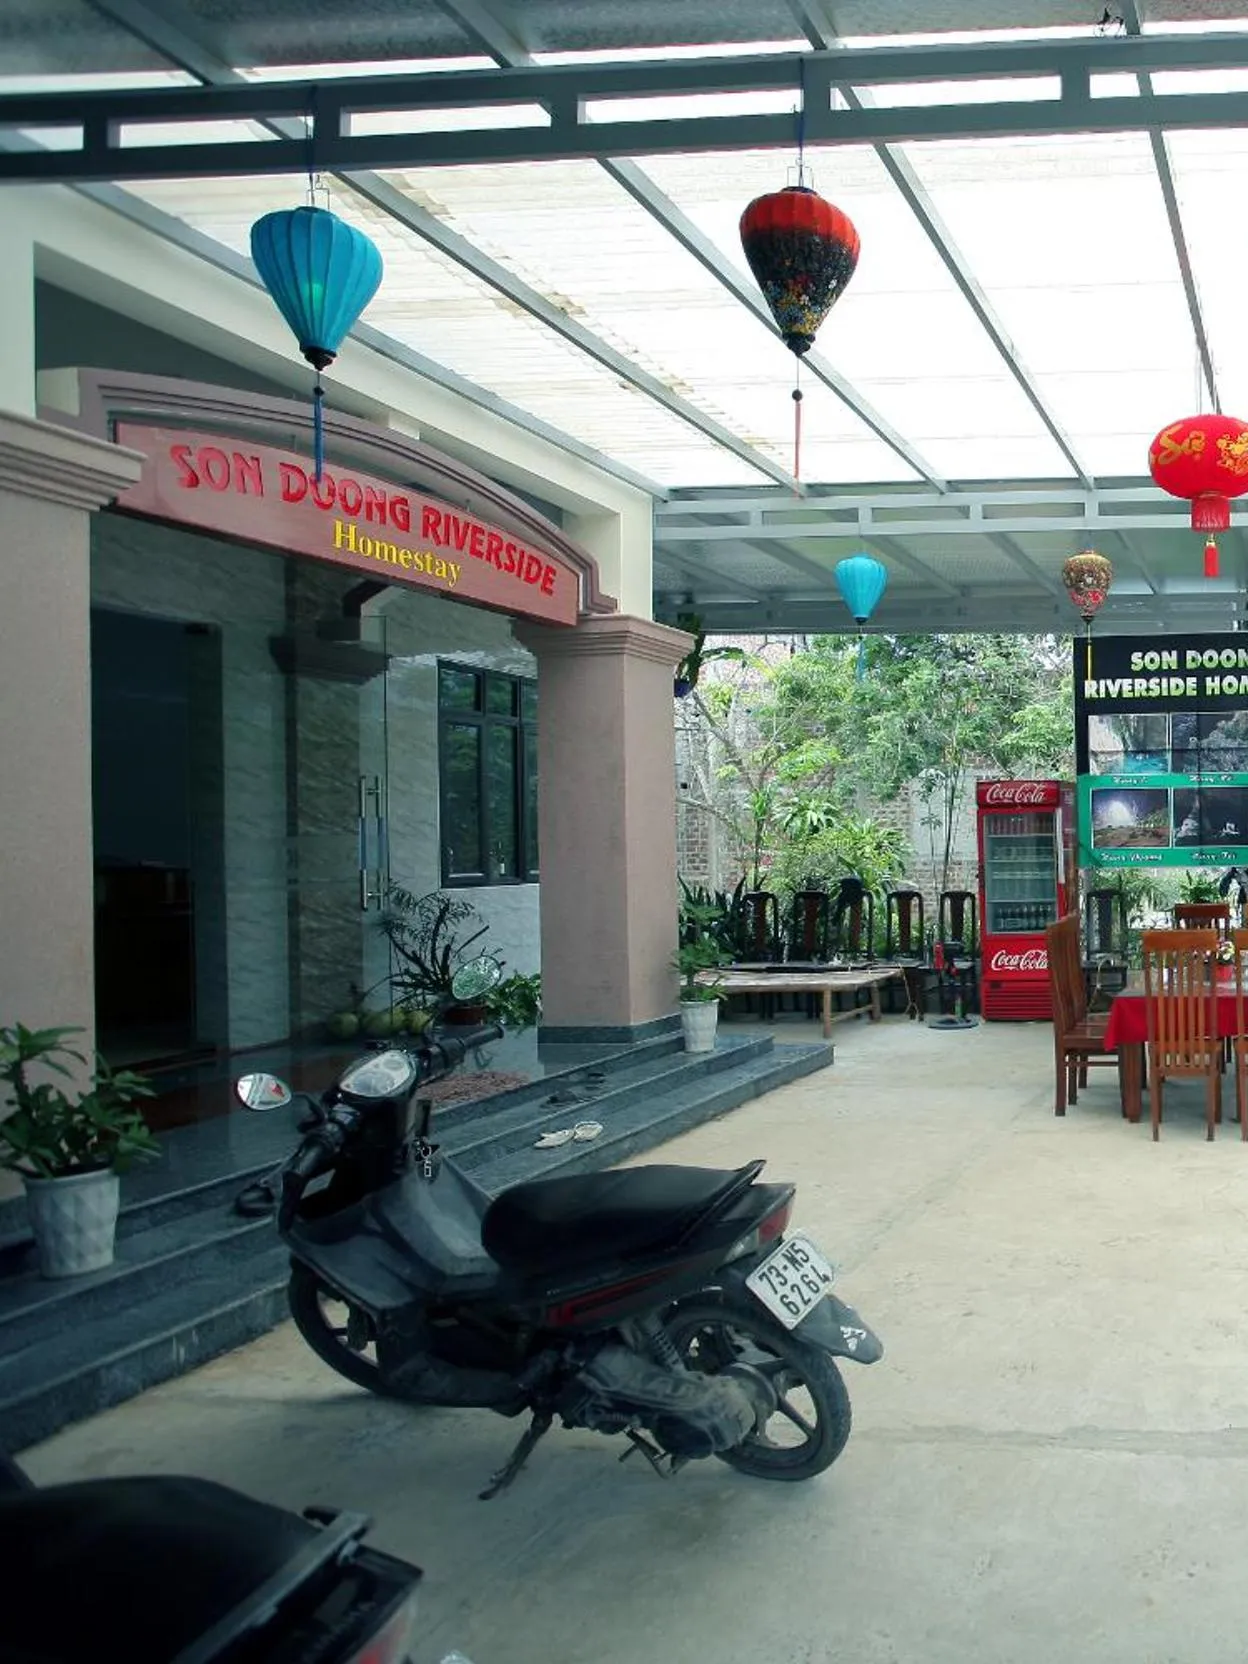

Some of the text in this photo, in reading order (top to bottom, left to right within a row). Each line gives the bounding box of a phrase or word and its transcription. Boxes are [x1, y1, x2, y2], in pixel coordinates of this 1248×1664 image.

[170, 444, 558, 597] SON DOONG RIVERSIDE
[332, 520, 461, 588] Homestay
[1131, 650, 1178, 671] SON
[1084, 676, 1198, 699] RIVERSIDE
[779, 1265, 831, 1316] 6264
